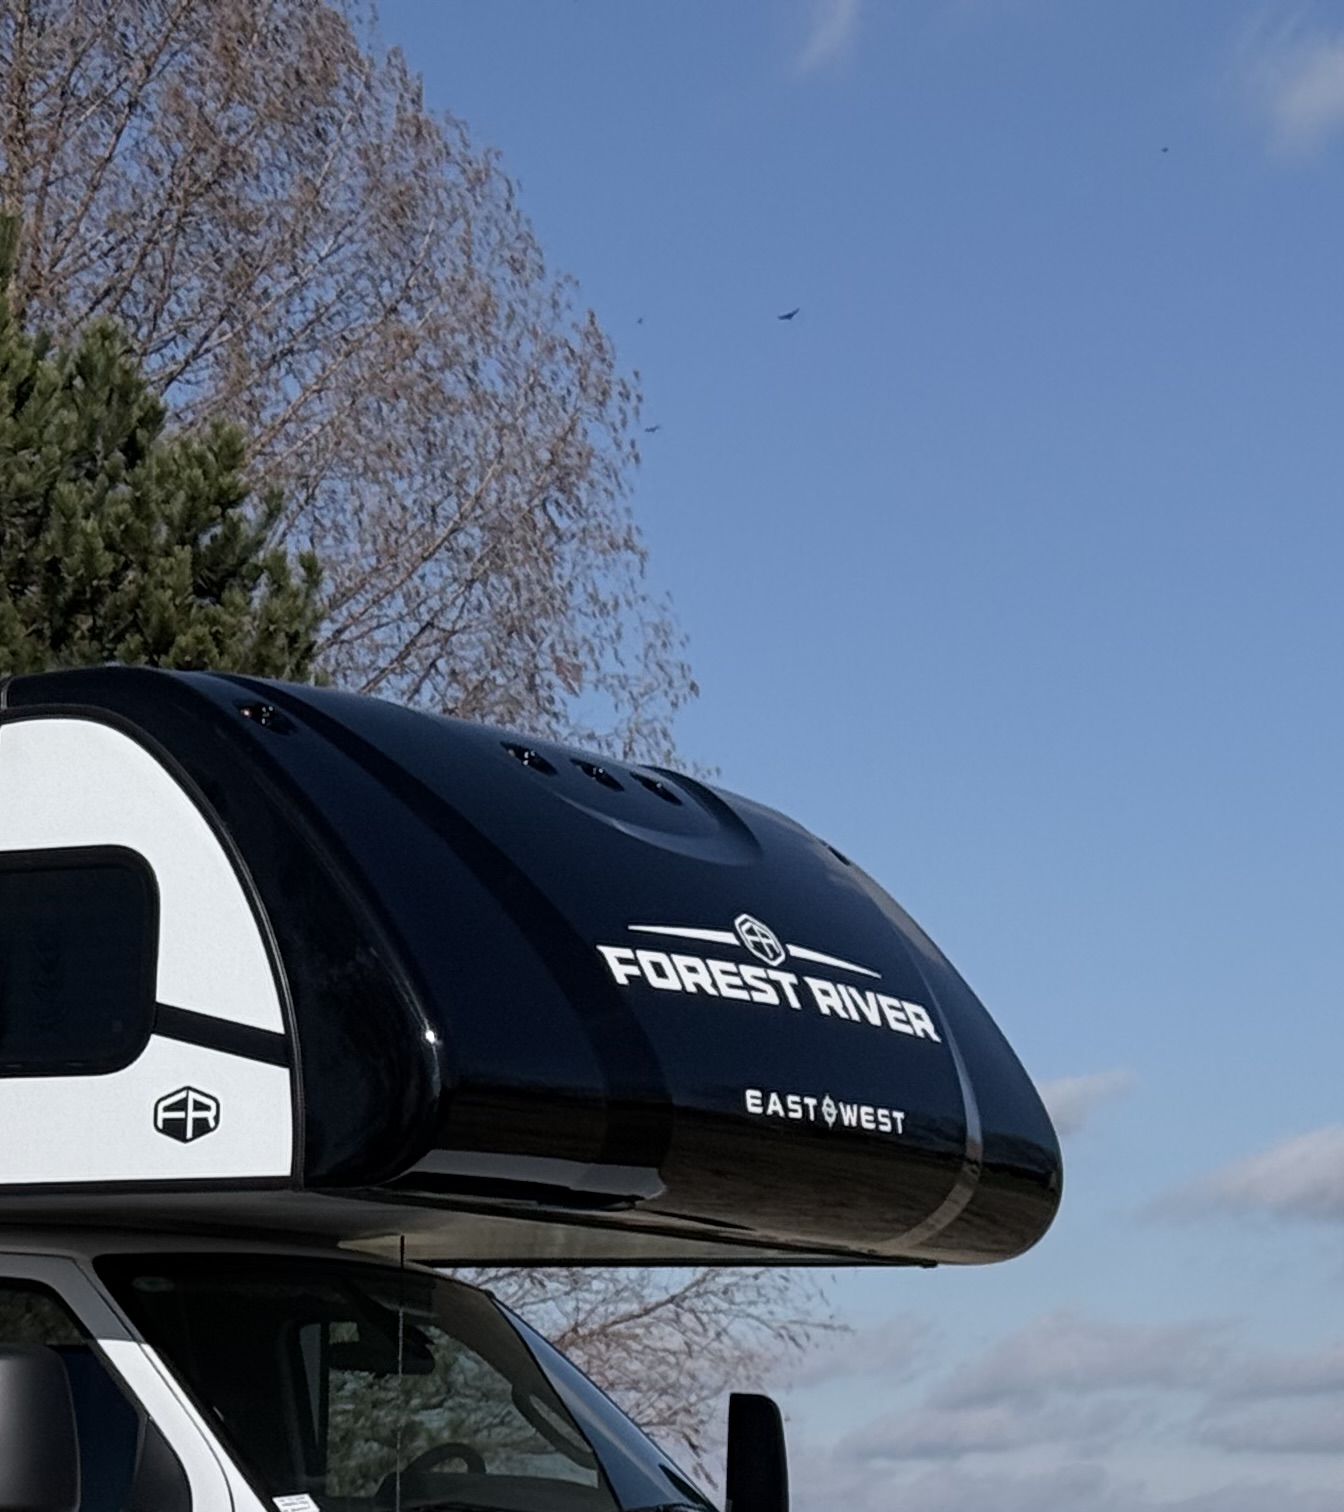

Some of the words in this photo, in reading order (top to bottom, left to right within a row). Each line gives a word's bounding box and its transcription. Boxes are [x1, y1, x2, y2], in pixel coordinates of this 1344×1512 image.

[597, 945, 802, 1010] FOREST
[804, 976, 942, 1043] RIVER
[746, 1089, 818, 1122] EAST
[838, 1101, 905, 1134] WEST
